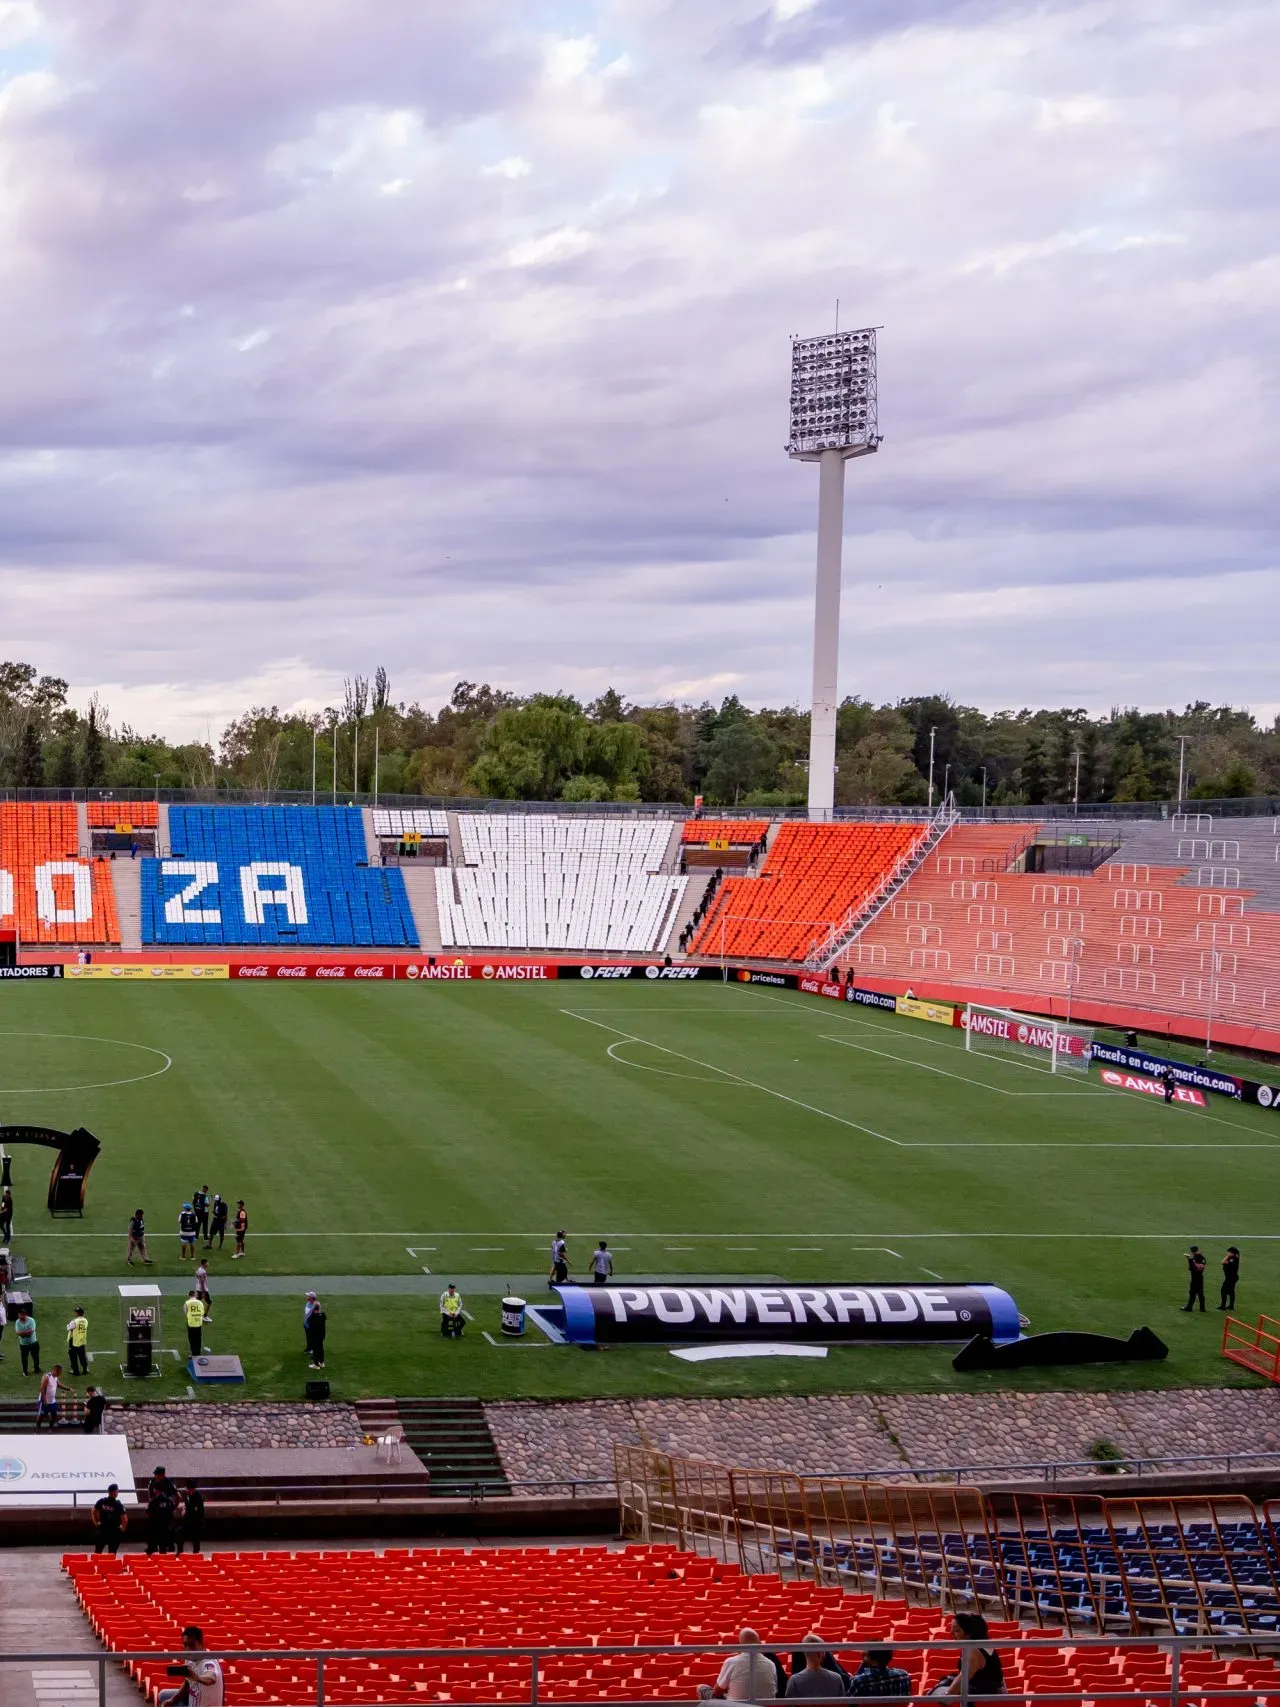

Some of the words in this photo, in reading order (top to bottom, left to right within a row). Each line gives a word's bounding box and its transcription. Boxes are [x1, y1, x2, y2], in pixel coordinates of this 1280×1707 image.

[420, 966, 471, 978] AMSTEL
[496, 966, 547, 978] AMSTEL
[594, 966, 632, 978] FC24
[659, 967, 699, 978] FC24
[752, 974, 785, 984] priceless
[855, 993, 895, 1008] crypto.com
[970, 1014, 1010, 1038] AMSTEL
[1092, 1044, 1126, 1063] Tickets
[1129, 1057, 1140, 1068] en
[1143, 1060, 1235, 1092] copamerica.com
[604, 1288, 957, 1323] POWERADE
[31, 1471, 116, 1479] ARGENTINA
